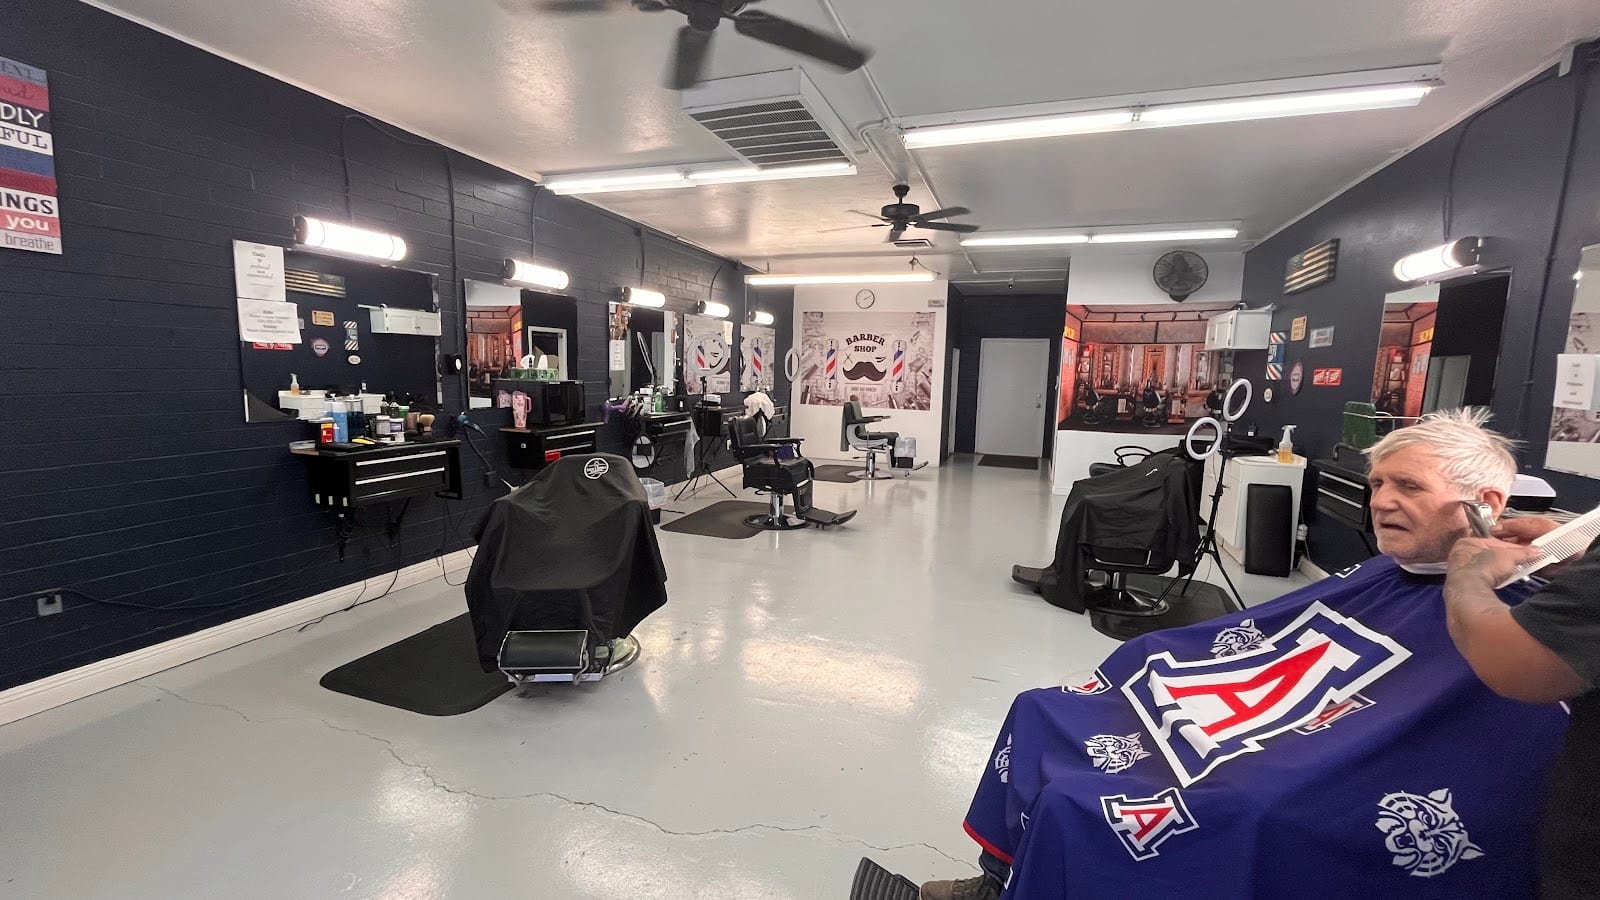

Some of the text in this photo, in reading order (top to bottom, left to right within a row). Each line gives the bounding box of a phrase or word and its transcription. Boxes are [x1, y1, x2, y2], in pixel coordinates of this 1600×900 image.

[0, 105, 44, 128] DLY
[0, 126, 48, 149] FUL
[5, 214, 50, 231] you
[4, 232, 54, 251] breathe
[845, 333, 886, 346] BARBER
[854, 345, 877, 353] SHOP
[1147, 627, 1361, 760] A
[1110, 795, 1185, 852] A
